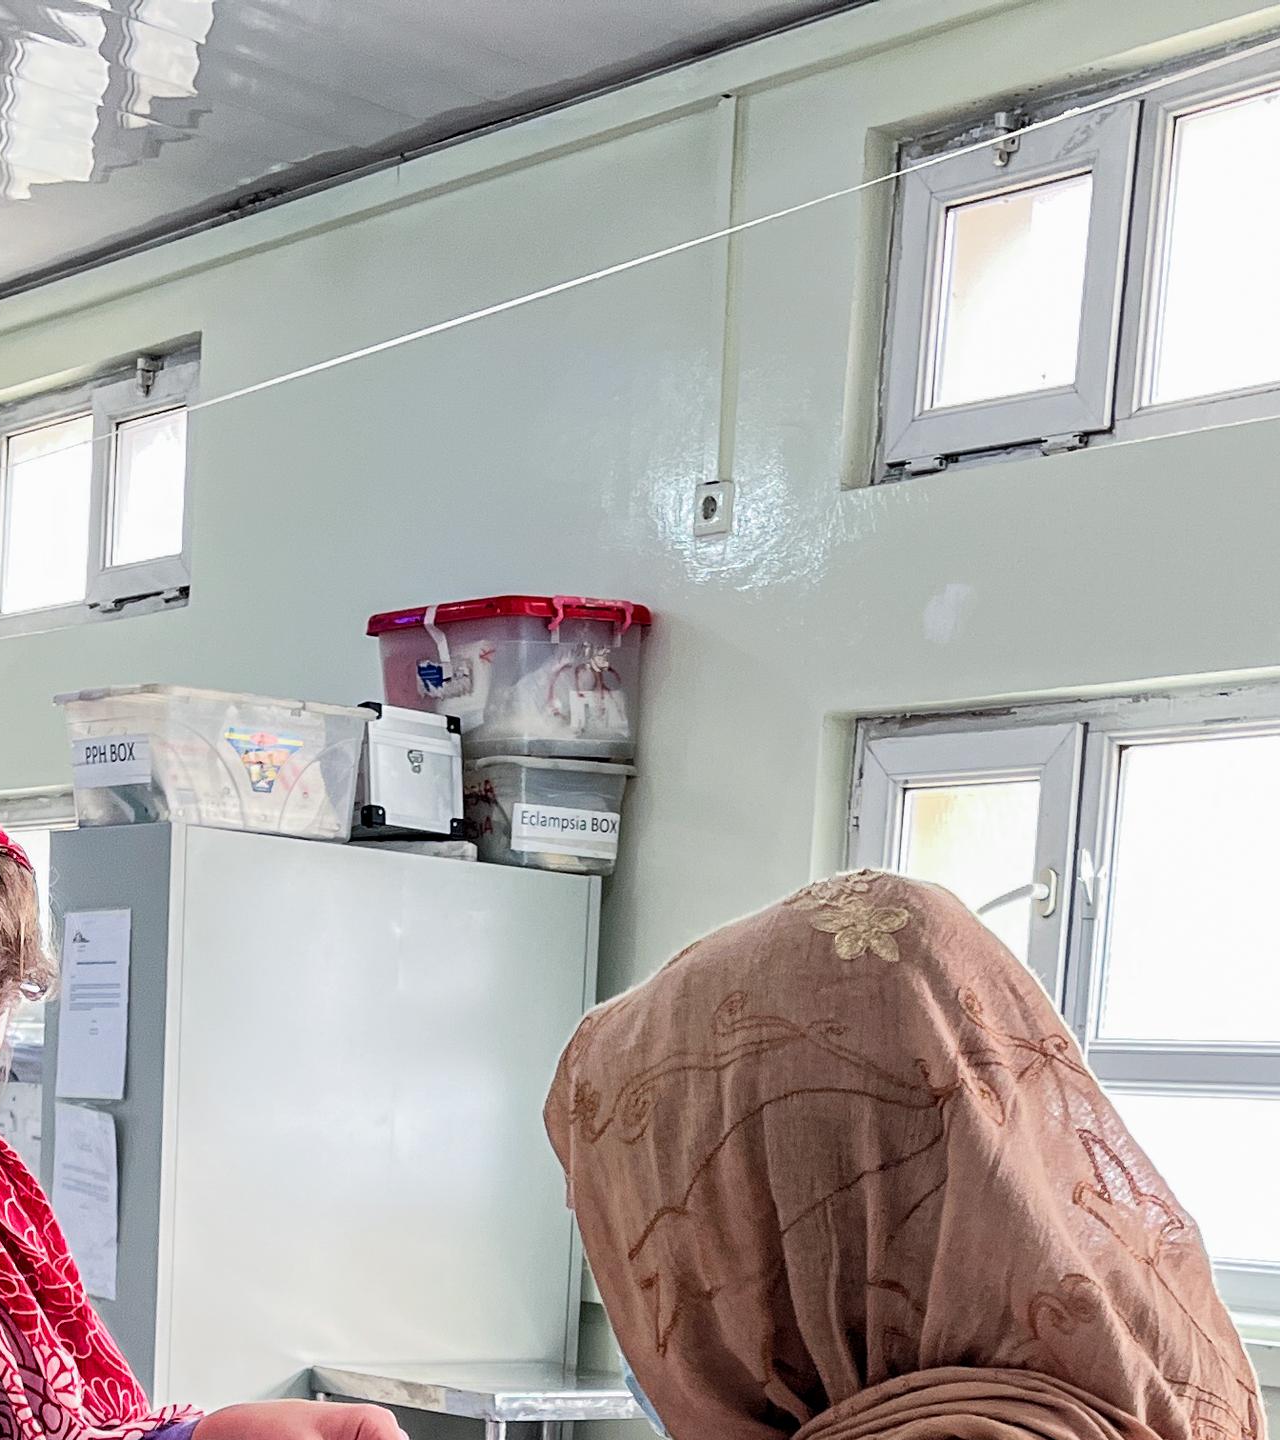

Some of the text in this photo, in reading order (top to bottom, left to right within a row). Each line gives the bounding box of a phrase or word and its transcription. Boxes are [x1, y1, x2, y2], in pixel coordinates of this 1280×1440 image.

[85, 742, 136, 764] PPH BOX
[520, 810, 619, 833] Eclampsia BOX
